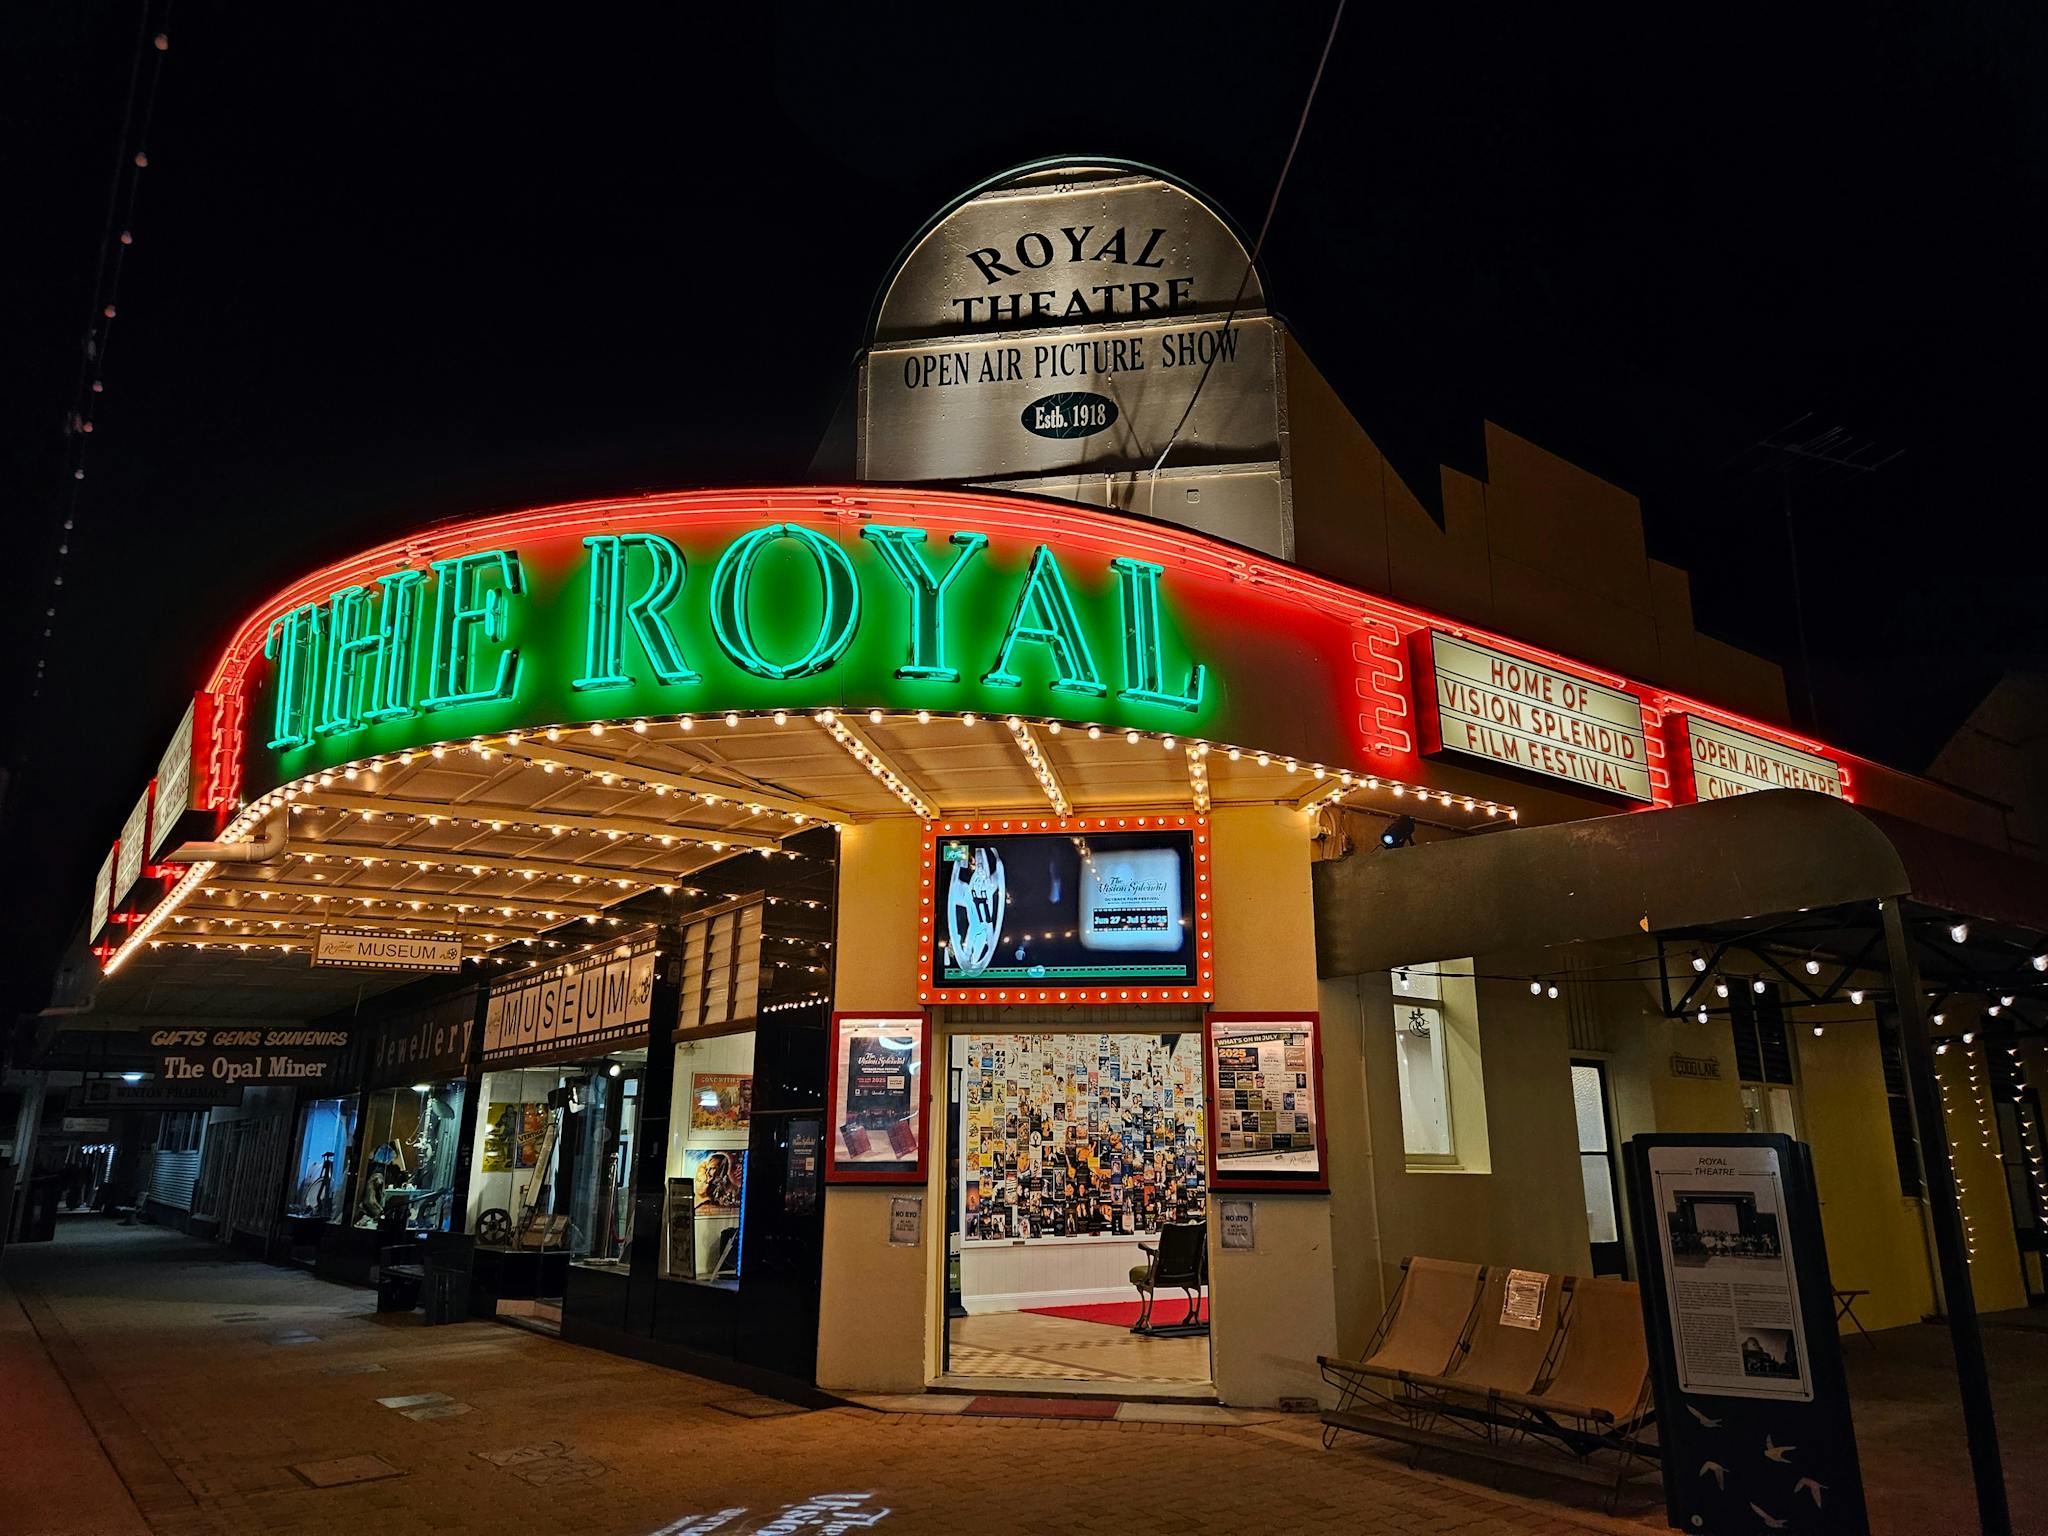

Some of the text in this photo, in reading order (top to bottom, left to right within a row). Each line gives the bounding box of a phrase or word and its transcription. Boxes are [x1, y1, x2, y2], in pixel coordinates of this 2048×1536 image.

[967, 226, 1167, 285] ROYAL
[952, 277, 1195, 330] THEATRE
[904, 328, 1240, 389] OPEN AIR PICTURE SHOW
[1035, 403, 1106, 430] Estb. 1918
[264, 523, 1206, 752] THE ROYAL
[1490, 658, 1588, 712] HOME OF
[1443, 679, 1635, 760] VISION SPLENDID
[1466, 724, 1628, 792] FILM FESTIVAL
[1696, 737, 1834, 794] OPEN AIR THEATRE
[1110, 916, 1121, 924] 27
[1127, 915, 1139, 924] Jul
[1147, 915, 1167, 924] 2025
[358, 942, 436, 960] MUSEUM
[504, 970, 626, 1037] MUSEUM
[151, 1030, 349, 1047] GIFTS GEMS SOUVENIRS
[376, 1018, 475, 1067] Jewellery
[1216, 1037, 1242, 1046] WHAT'S
[1262, 1033, 1278, 1042] JULY
[1218, 1048, 1247, 1058] 2025
[164, 1056, 327, 1084] The Opal Miner
[1694, 1167, 1736, 1176] THEATRE
[1698, 1157, 1728, 1166] ROYAL
